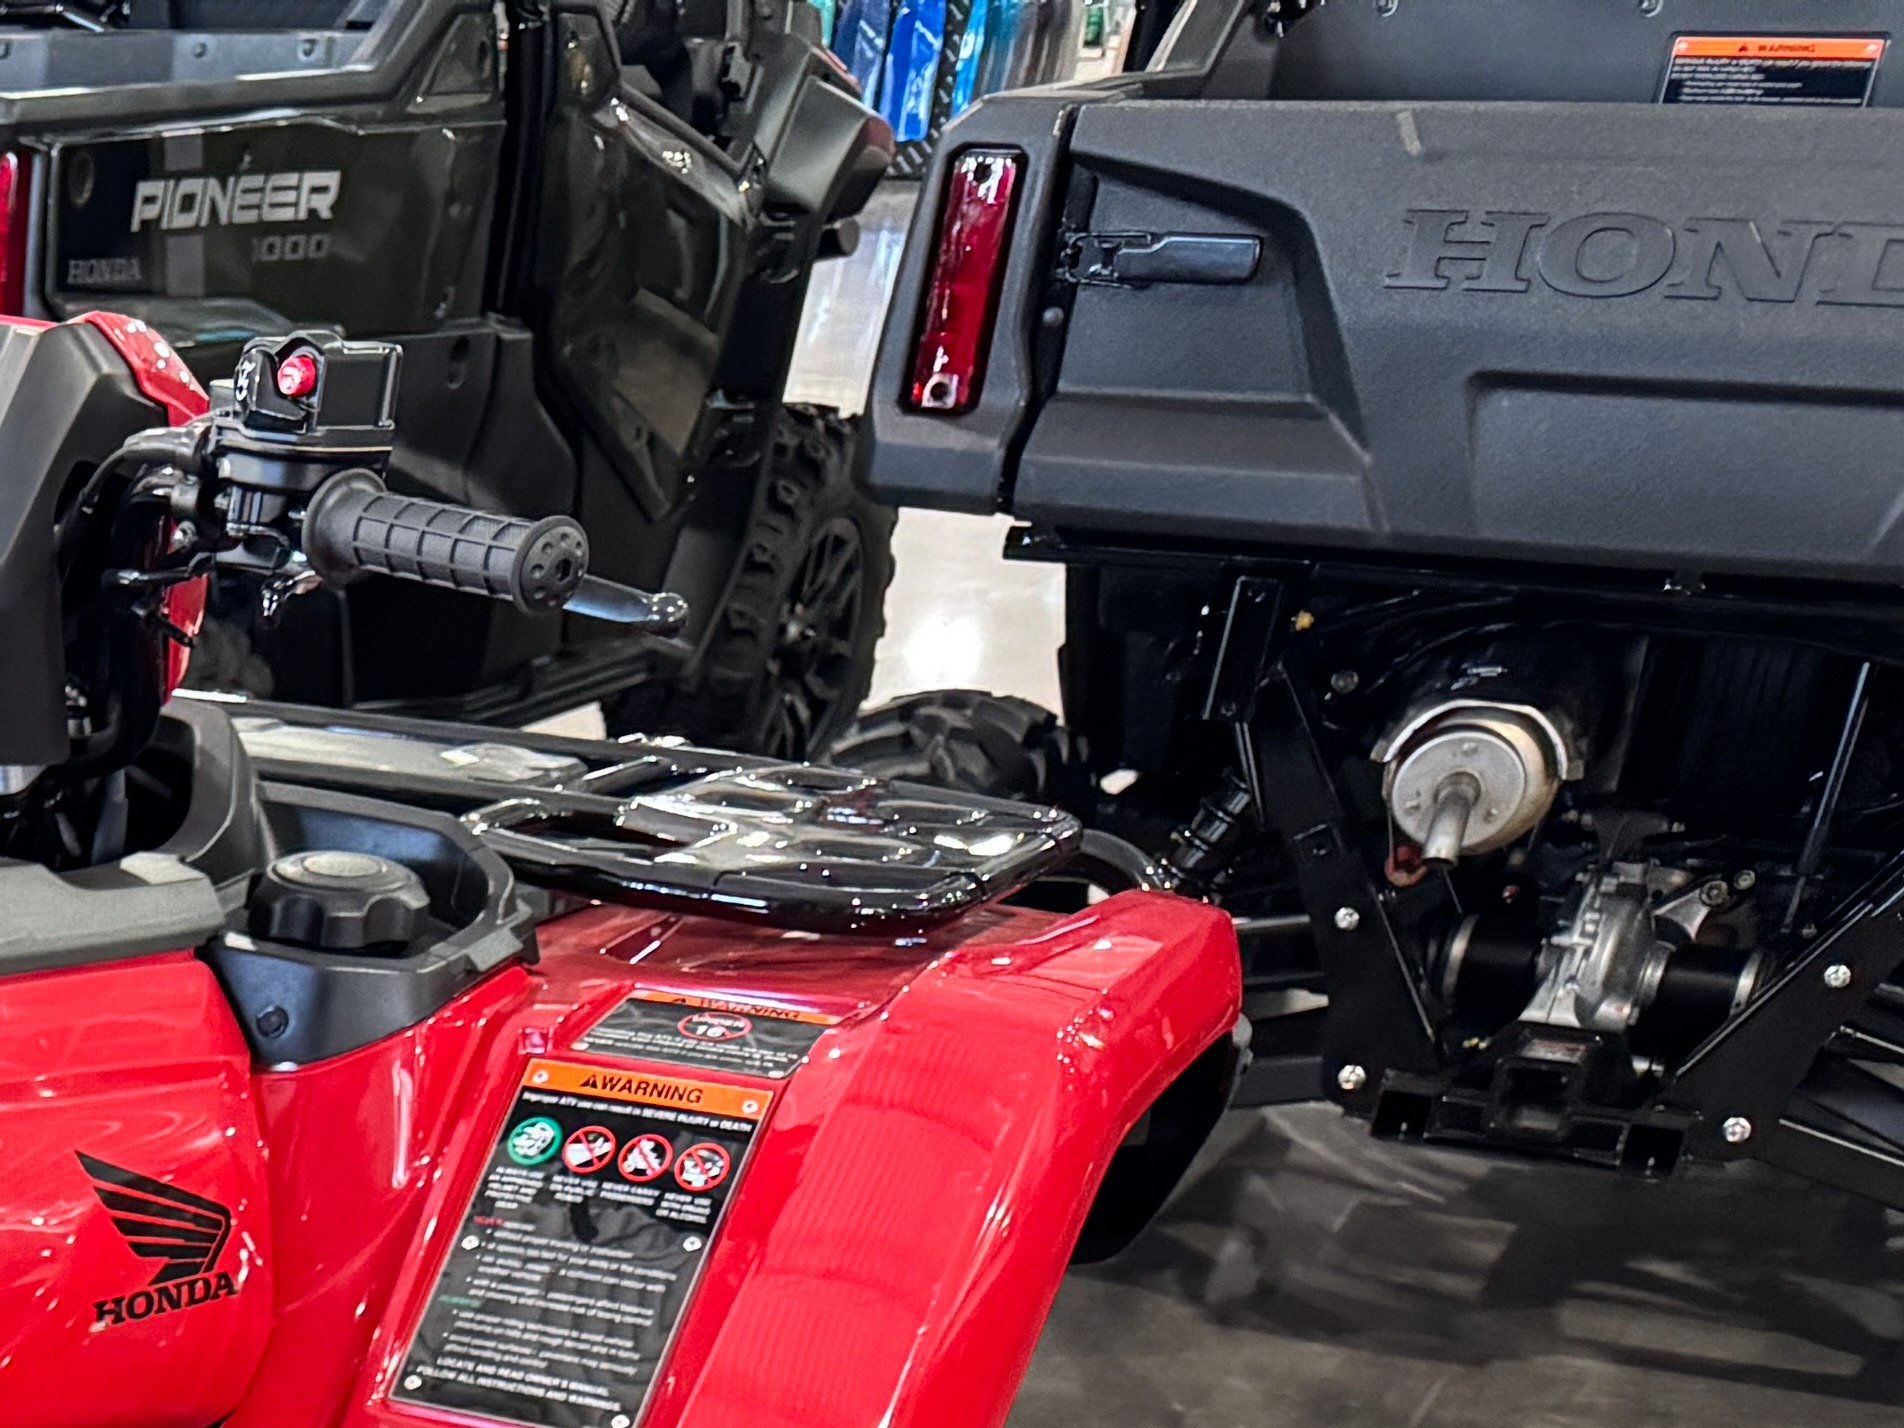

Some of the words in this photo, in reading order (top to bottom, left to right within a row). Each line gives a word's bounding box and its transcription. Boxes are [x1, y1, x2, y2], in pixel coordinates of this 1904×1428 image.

[130, 170, 342, 233] PIONEER
[600, 1074, 705, 1104] WARNING
[93, 1271, 239, 1326] HONDA
